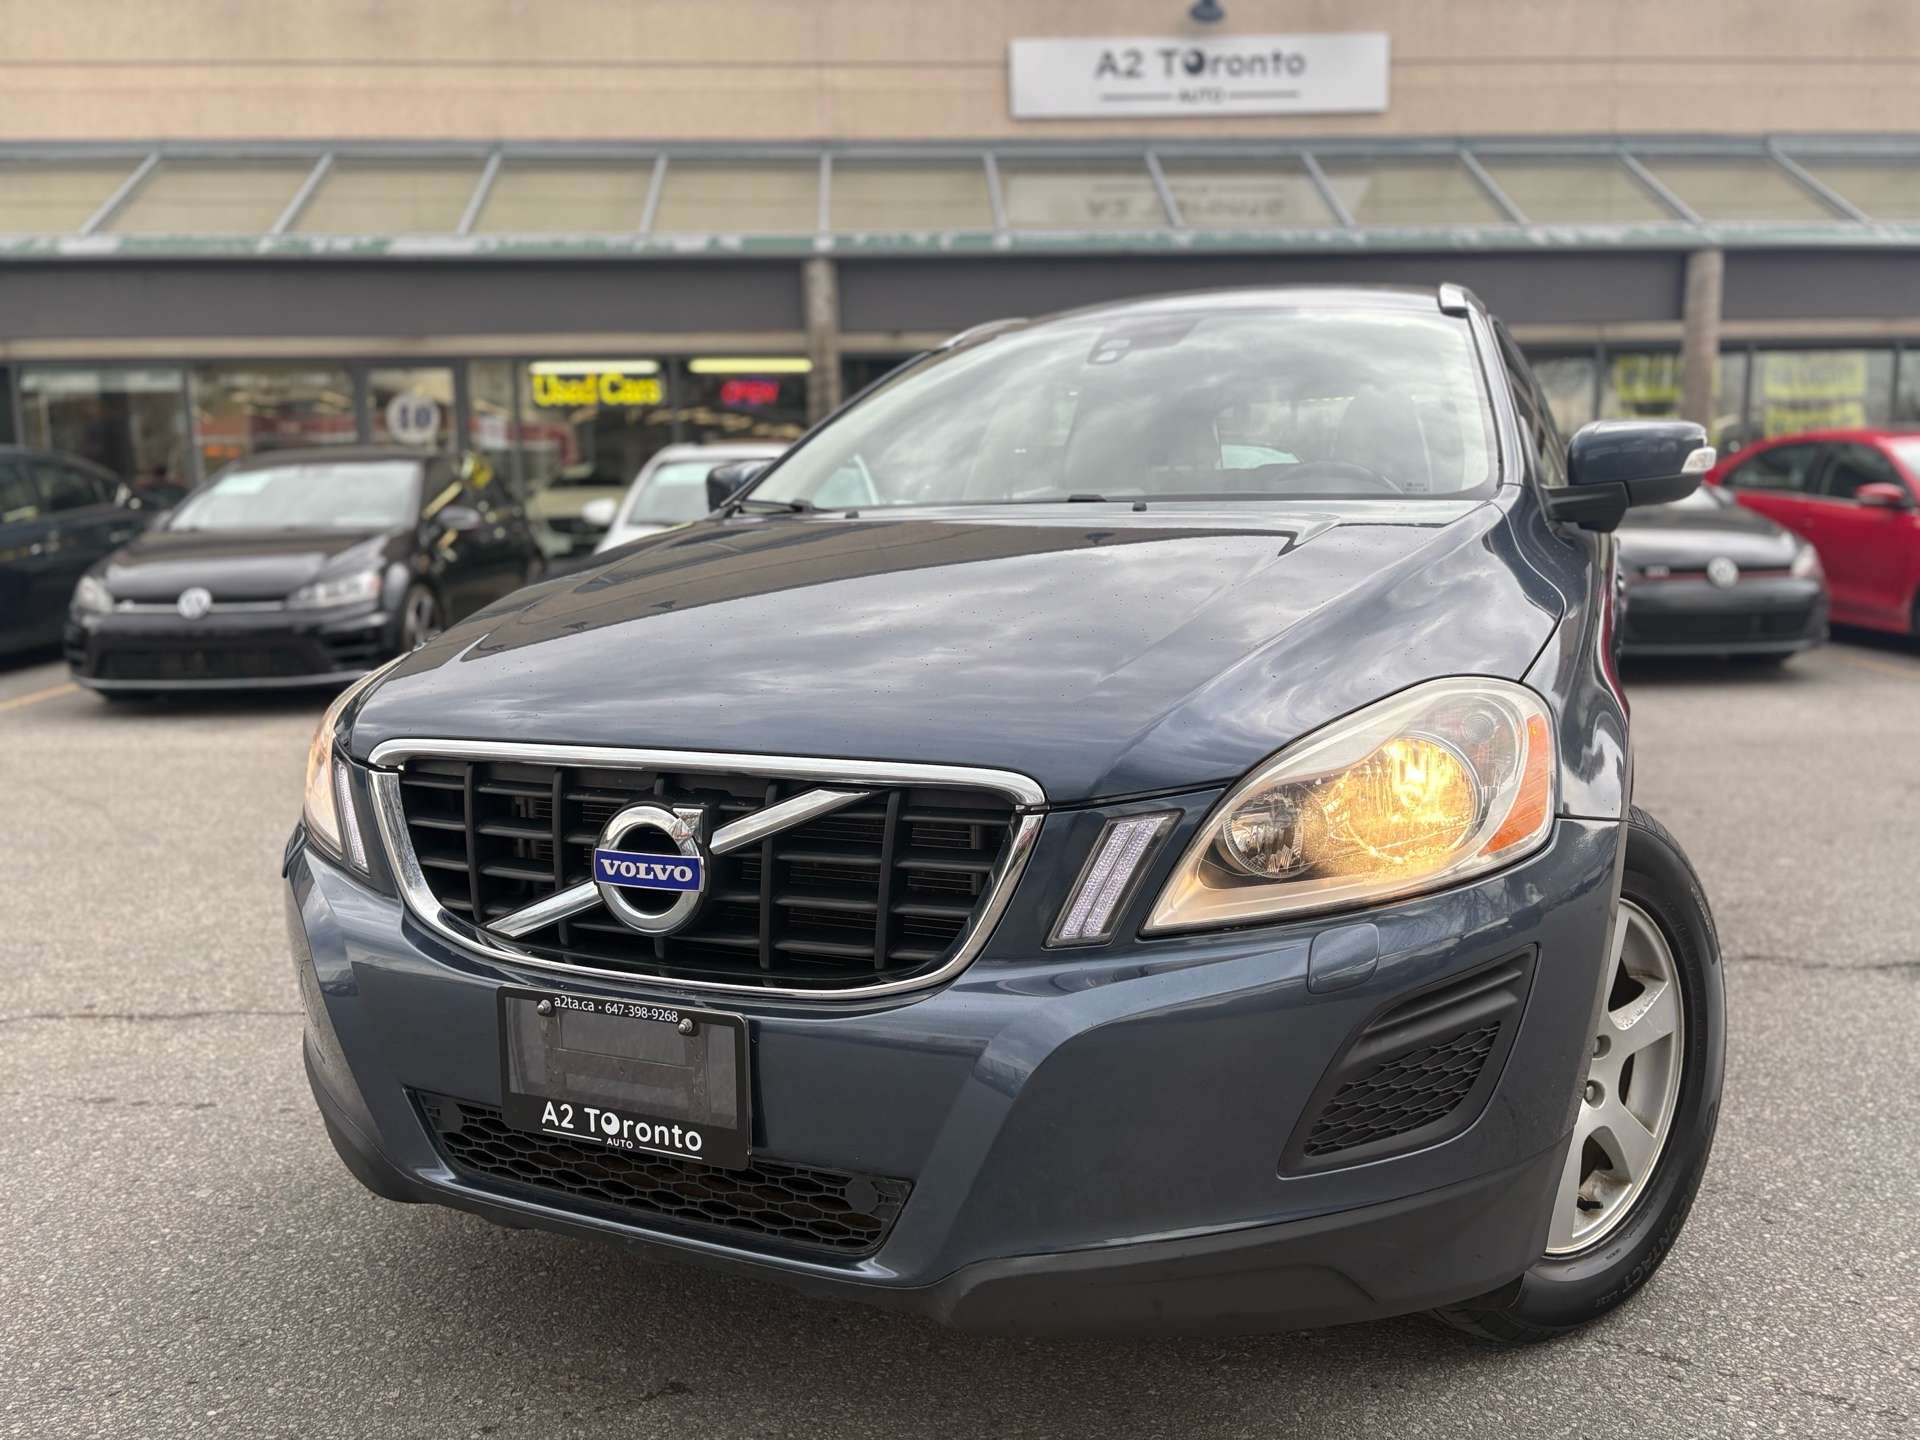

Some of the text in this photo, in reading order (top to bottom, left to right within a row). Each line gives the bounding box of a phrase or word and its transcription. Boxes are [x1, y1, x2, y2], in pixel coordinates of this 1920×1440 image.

[1095, 50, 1142, 79] A2
[600, 858, 693, 882] VOLVO
[554, 995, 679, 1023] a2ta.ca 647-398-9268
[541, 1101, 575, 1129] A2
[606, 1137, 634, 1149] AUTO
